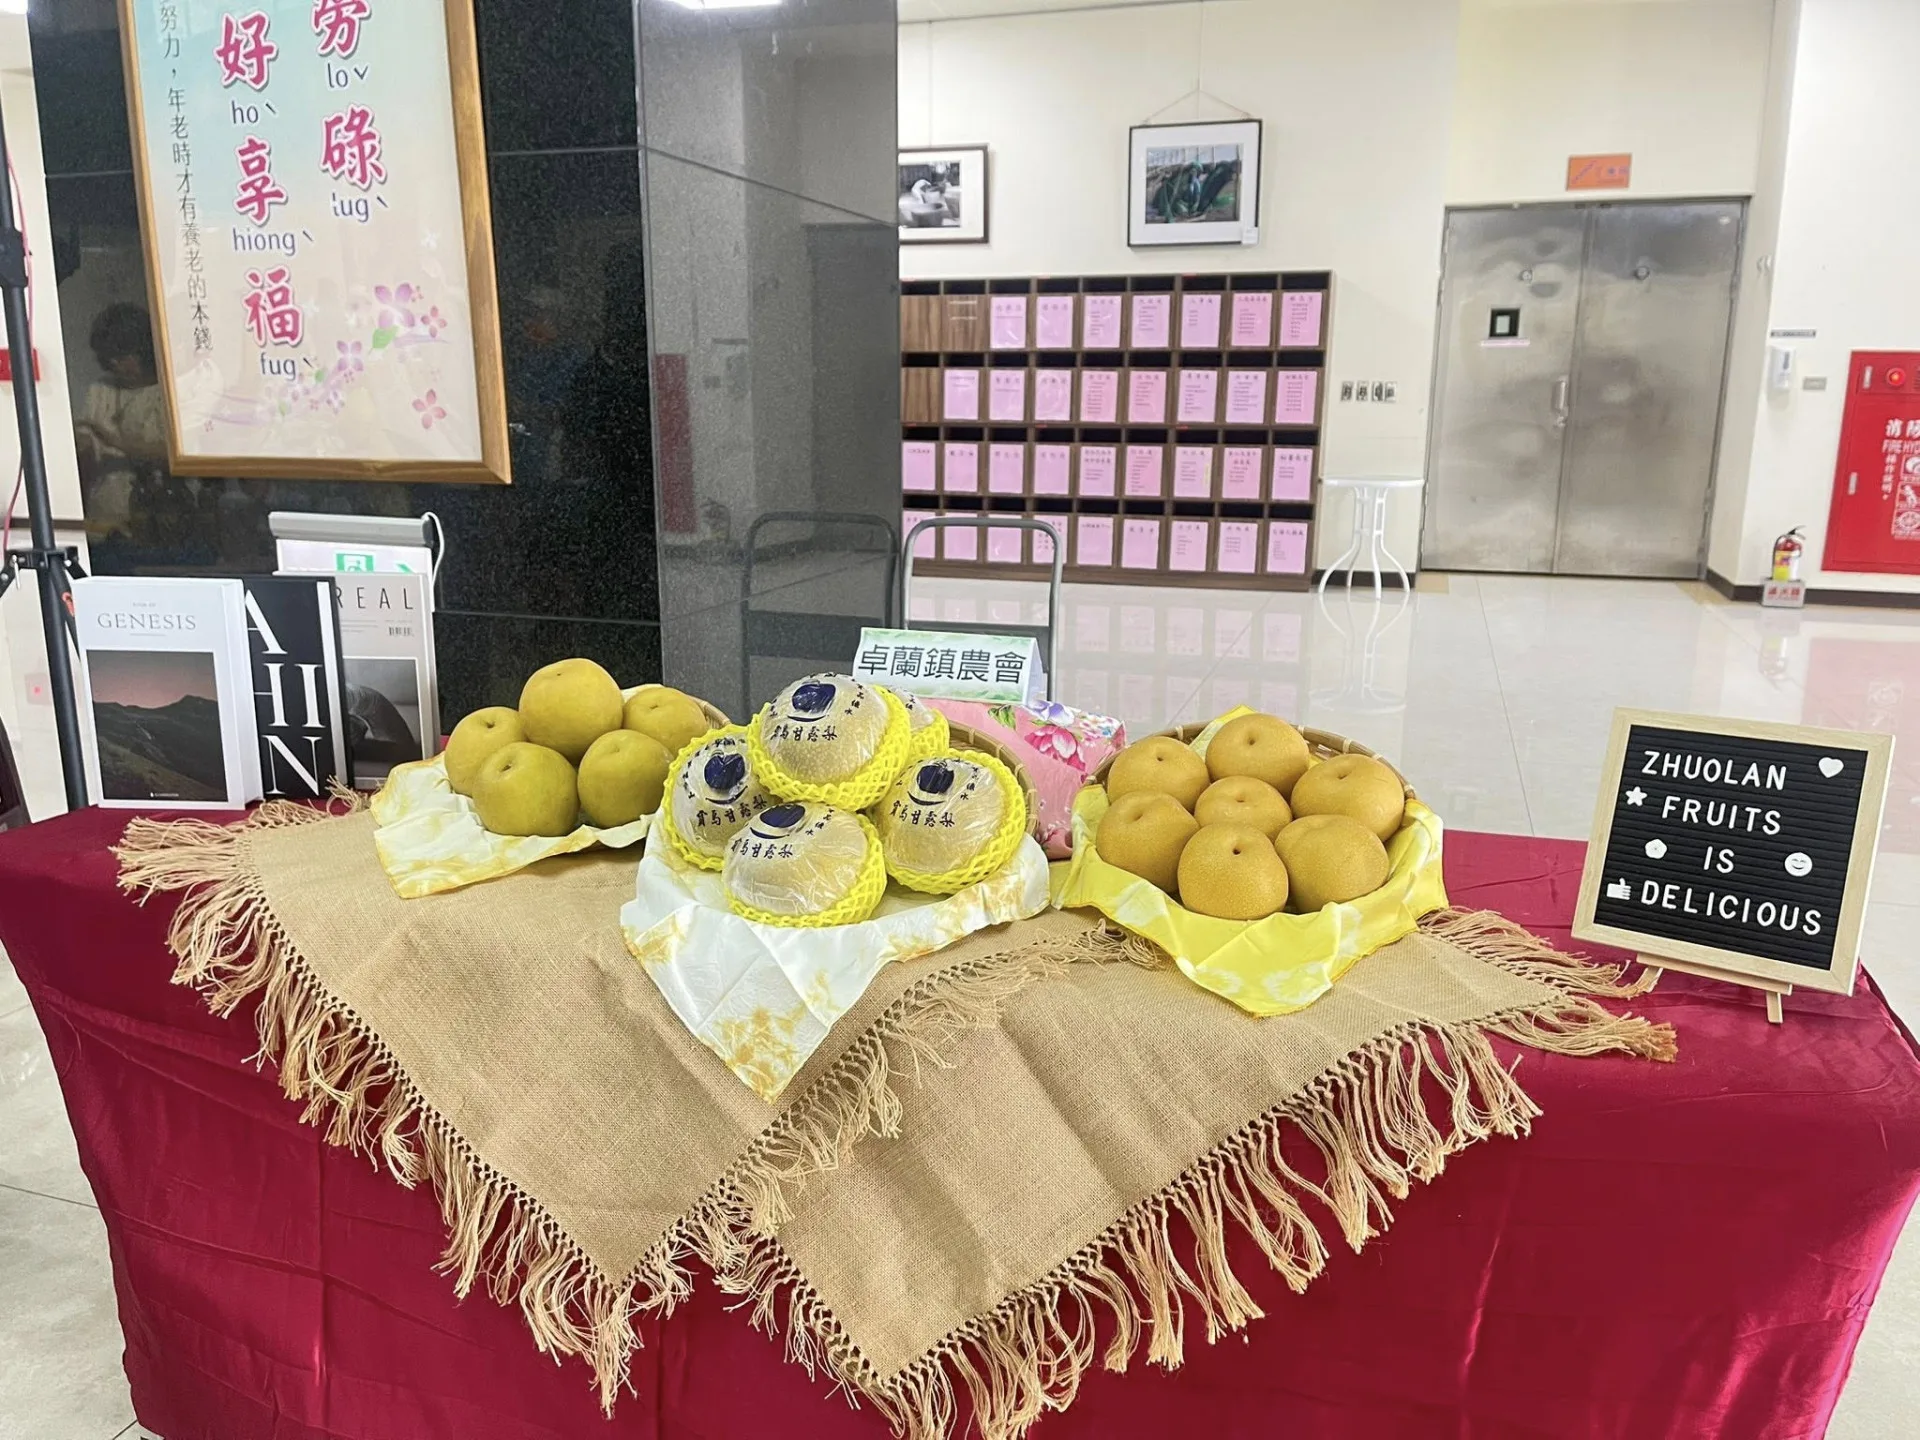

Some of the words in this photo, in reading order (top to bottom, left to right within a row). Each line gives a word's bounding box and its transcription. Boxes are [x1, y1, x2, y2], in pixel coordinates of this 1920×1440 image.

[215, 12, 277, 90] 好
[160, 0, 214, 350] 努力，年老時才有養老的本錢
[323, 107, 386, 188] 碌
[235, 136, 287, 225] 享
[244, 268, 302, 347] 福
[97, 612, 197, 631] GENESIS
[858, 644, 1027, 685] 卓蘭鎮農會
[1641, 750, 1787, 791] ZHUOLAN
[1662, 795, 1782, 836] FRUITS
[1703, 845, 1735, 874] IS
[1640, 880, 1822, 936] DELICIOUS
